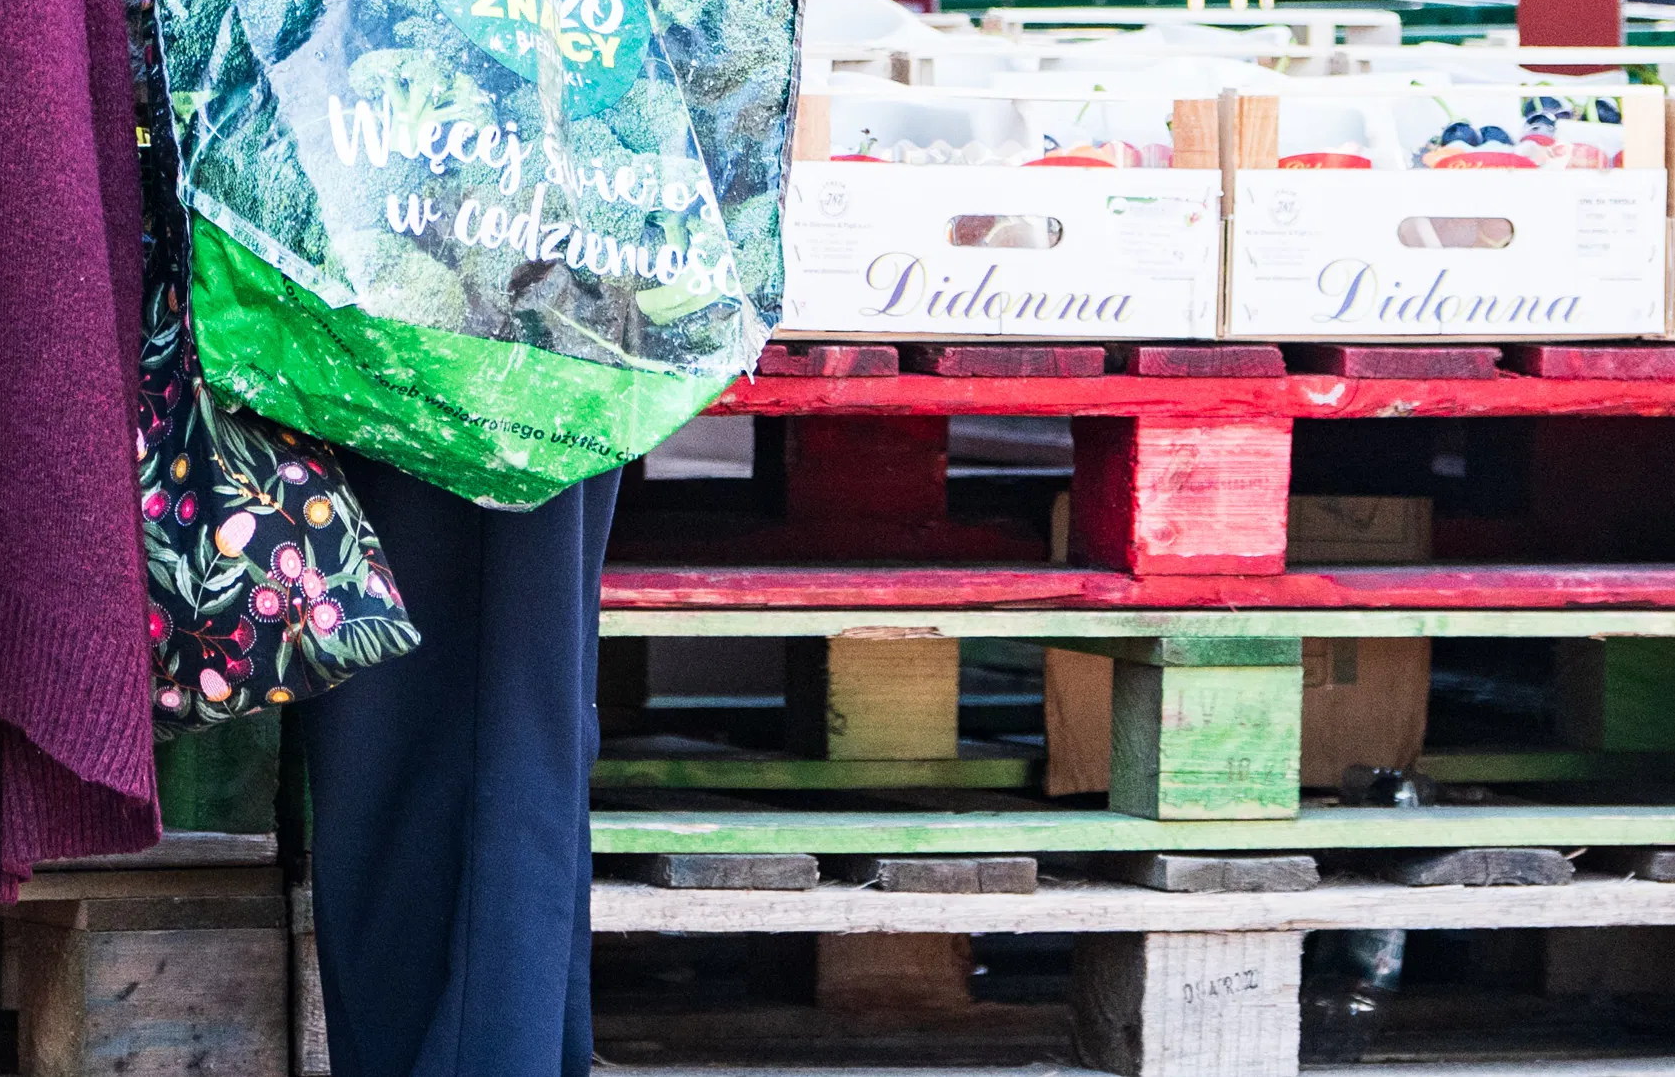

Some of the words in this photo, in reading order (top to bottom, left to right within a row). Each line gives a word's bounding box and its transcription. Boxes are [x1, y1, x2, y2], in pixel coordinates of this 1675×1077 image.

[386, 190, 442, 237] w
[858, 251, 1135, 322] Didonna
[1311, 257, 1582, 324] Didonna
